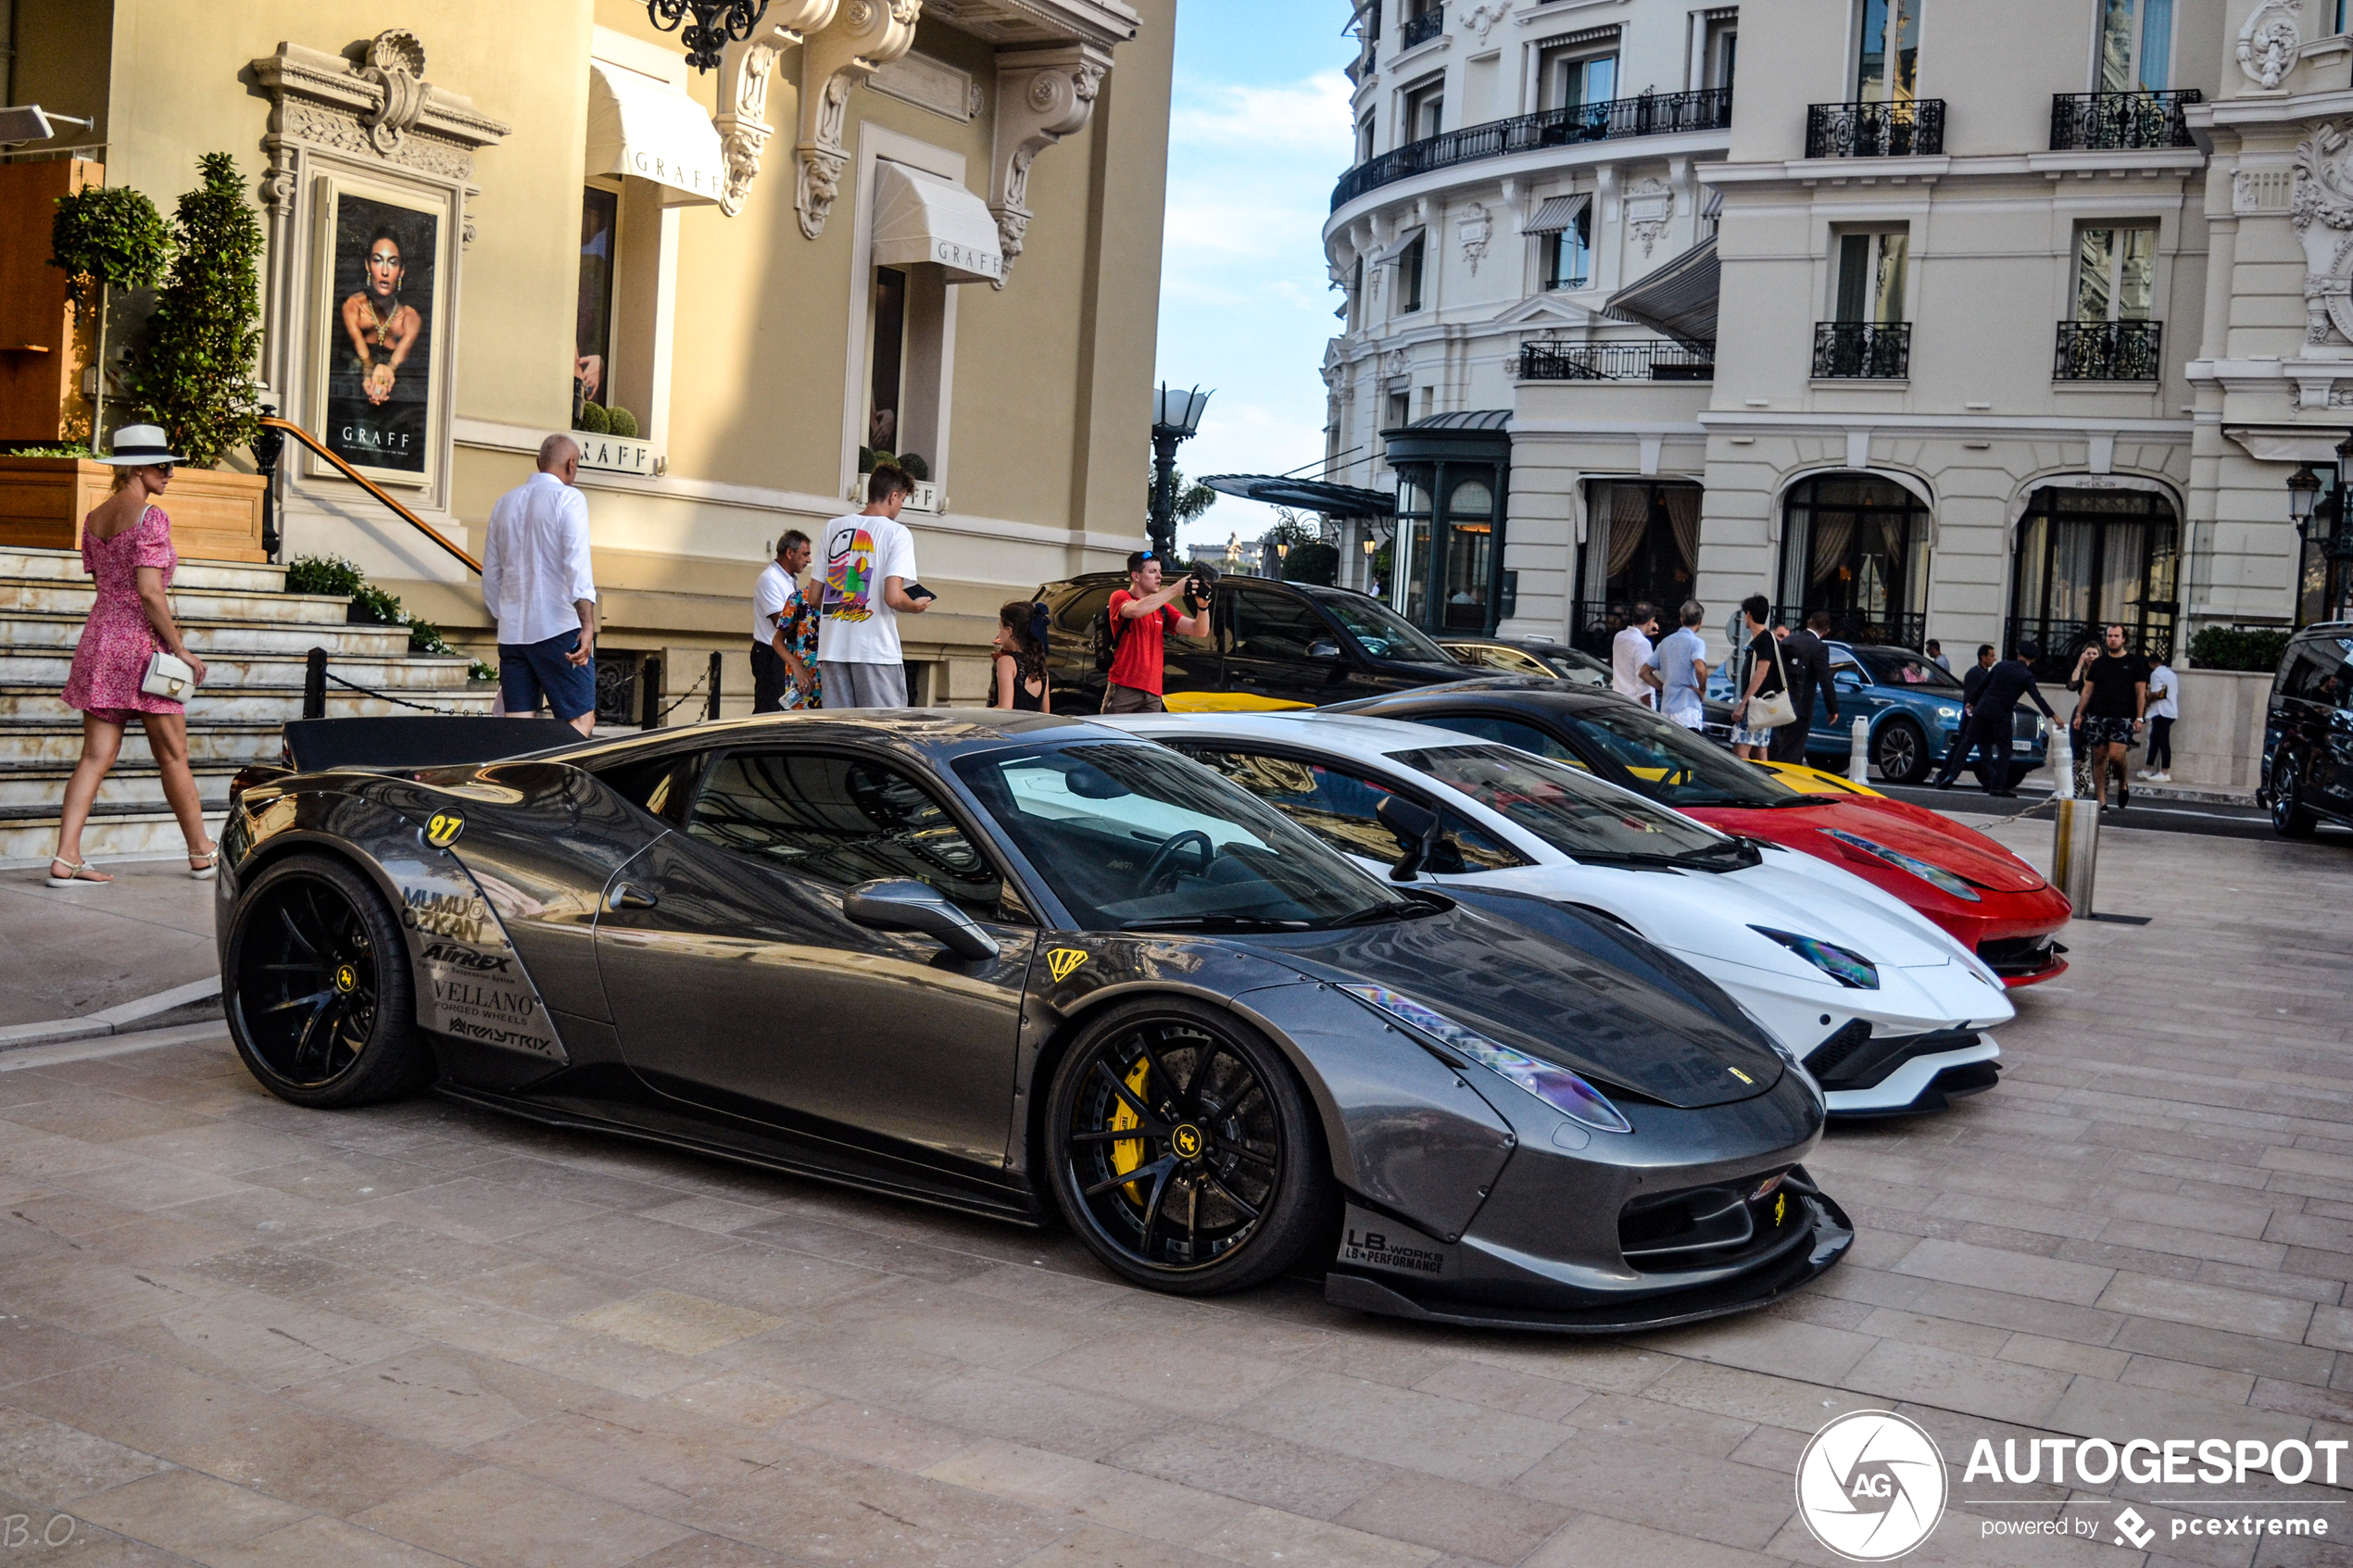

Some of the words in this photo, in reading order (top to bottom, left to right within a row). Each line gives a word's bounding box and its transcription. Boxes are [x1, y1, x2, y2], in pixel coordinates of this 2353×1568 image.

[635, 152, 720, 194] GRAFF
[938, 242, 1000, 273] GRAFF
[343, 426, 409, 447] GRAFF
[579, 442, 647, 467] RAFF
[428, 814, 463, 841] 97
[401, 907, 483, 944] OZKAN
[451, 966, 489, 980] Suspension
[492, 974, 516, 985] System
[434, 981, 534, 1016] VELLANO
[434, 1001, 479, 1017] FORGED
[483, 1010, 528, 1026] WHEELS
